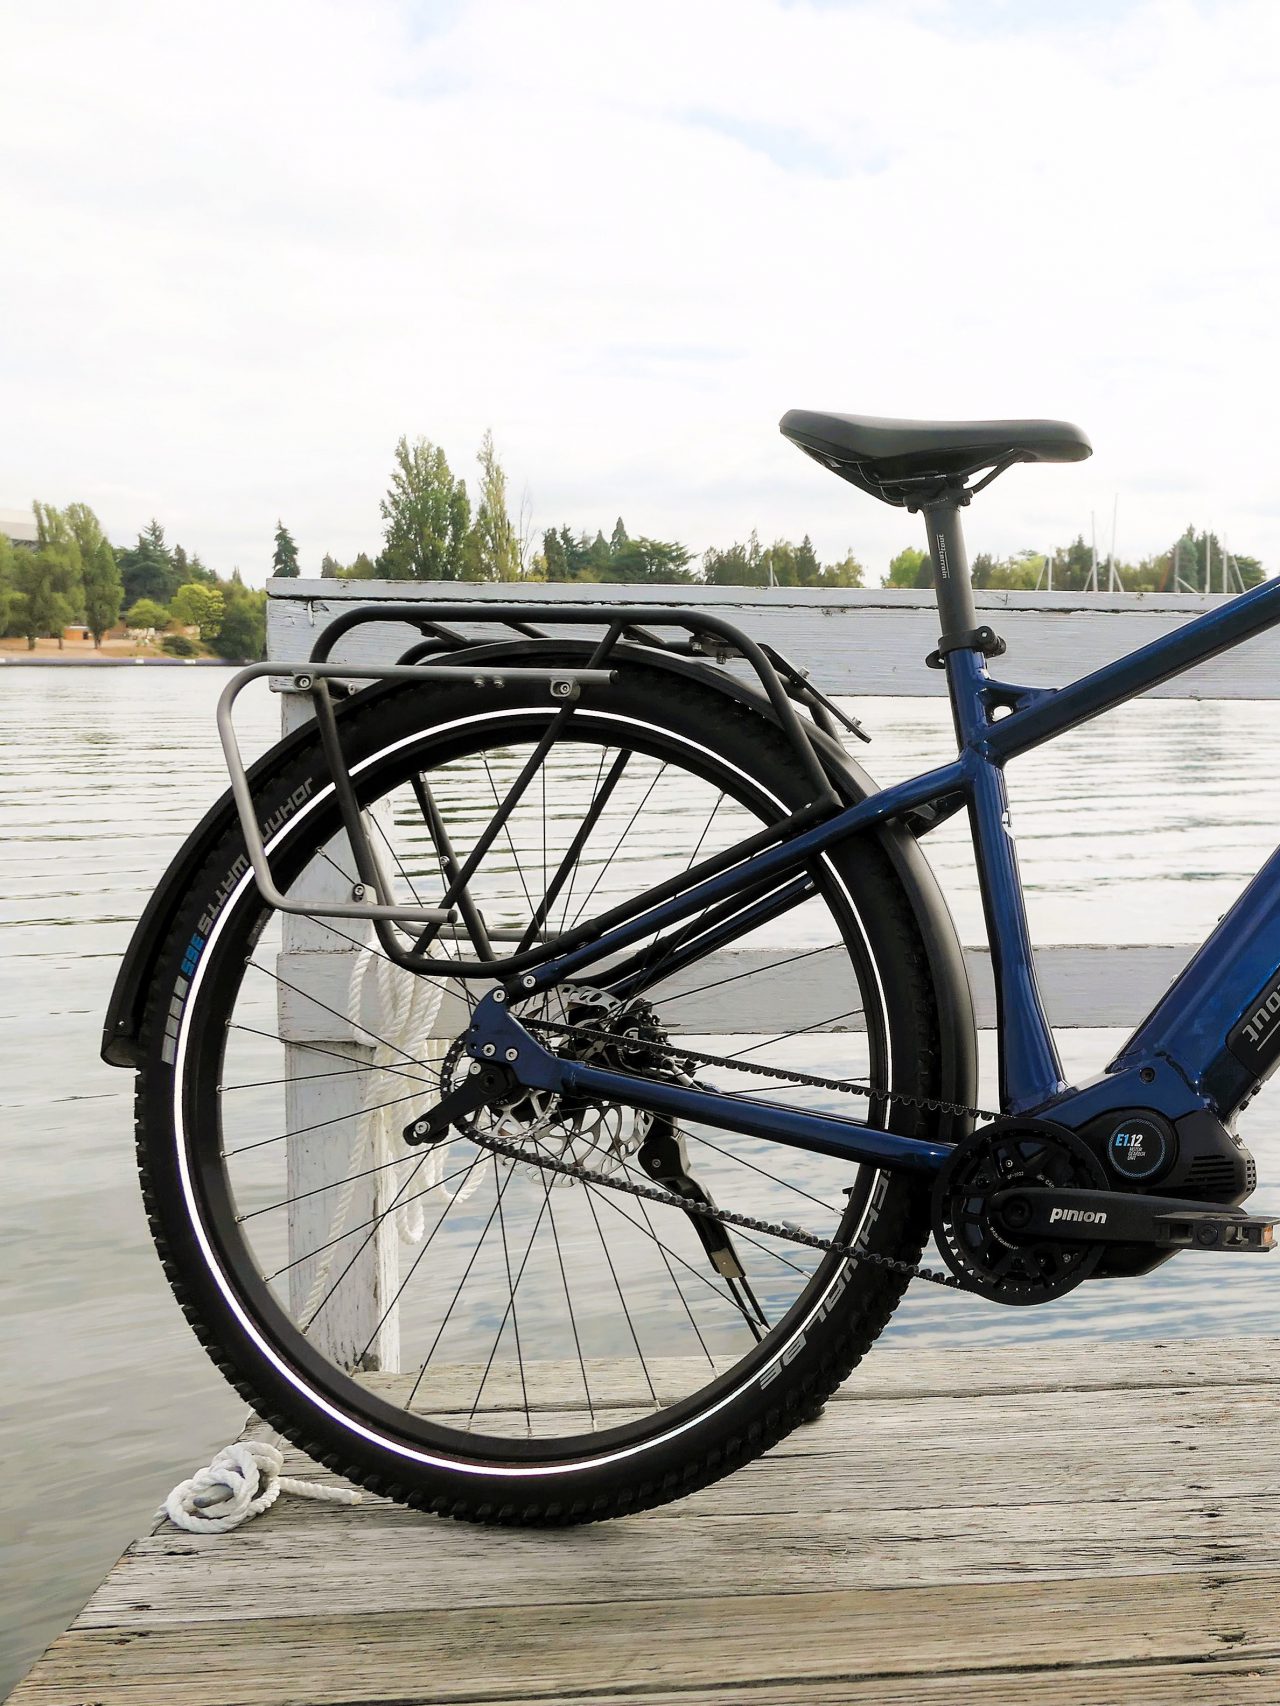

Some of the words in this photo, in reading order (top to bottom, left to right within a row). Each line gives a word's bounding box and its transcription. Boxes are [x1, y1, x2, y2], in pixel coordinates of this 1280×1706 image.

[261, 777, 313, 844] JOHNN
[197, 854, 249, 936] WATTS
[180, 932, 205, 977] 365
[1115, 1133, 1144, 1147] E1.12
[1050, 1207, 1107, 1224] pinion
[759, 1169, 892, 1390] CHWALBE
